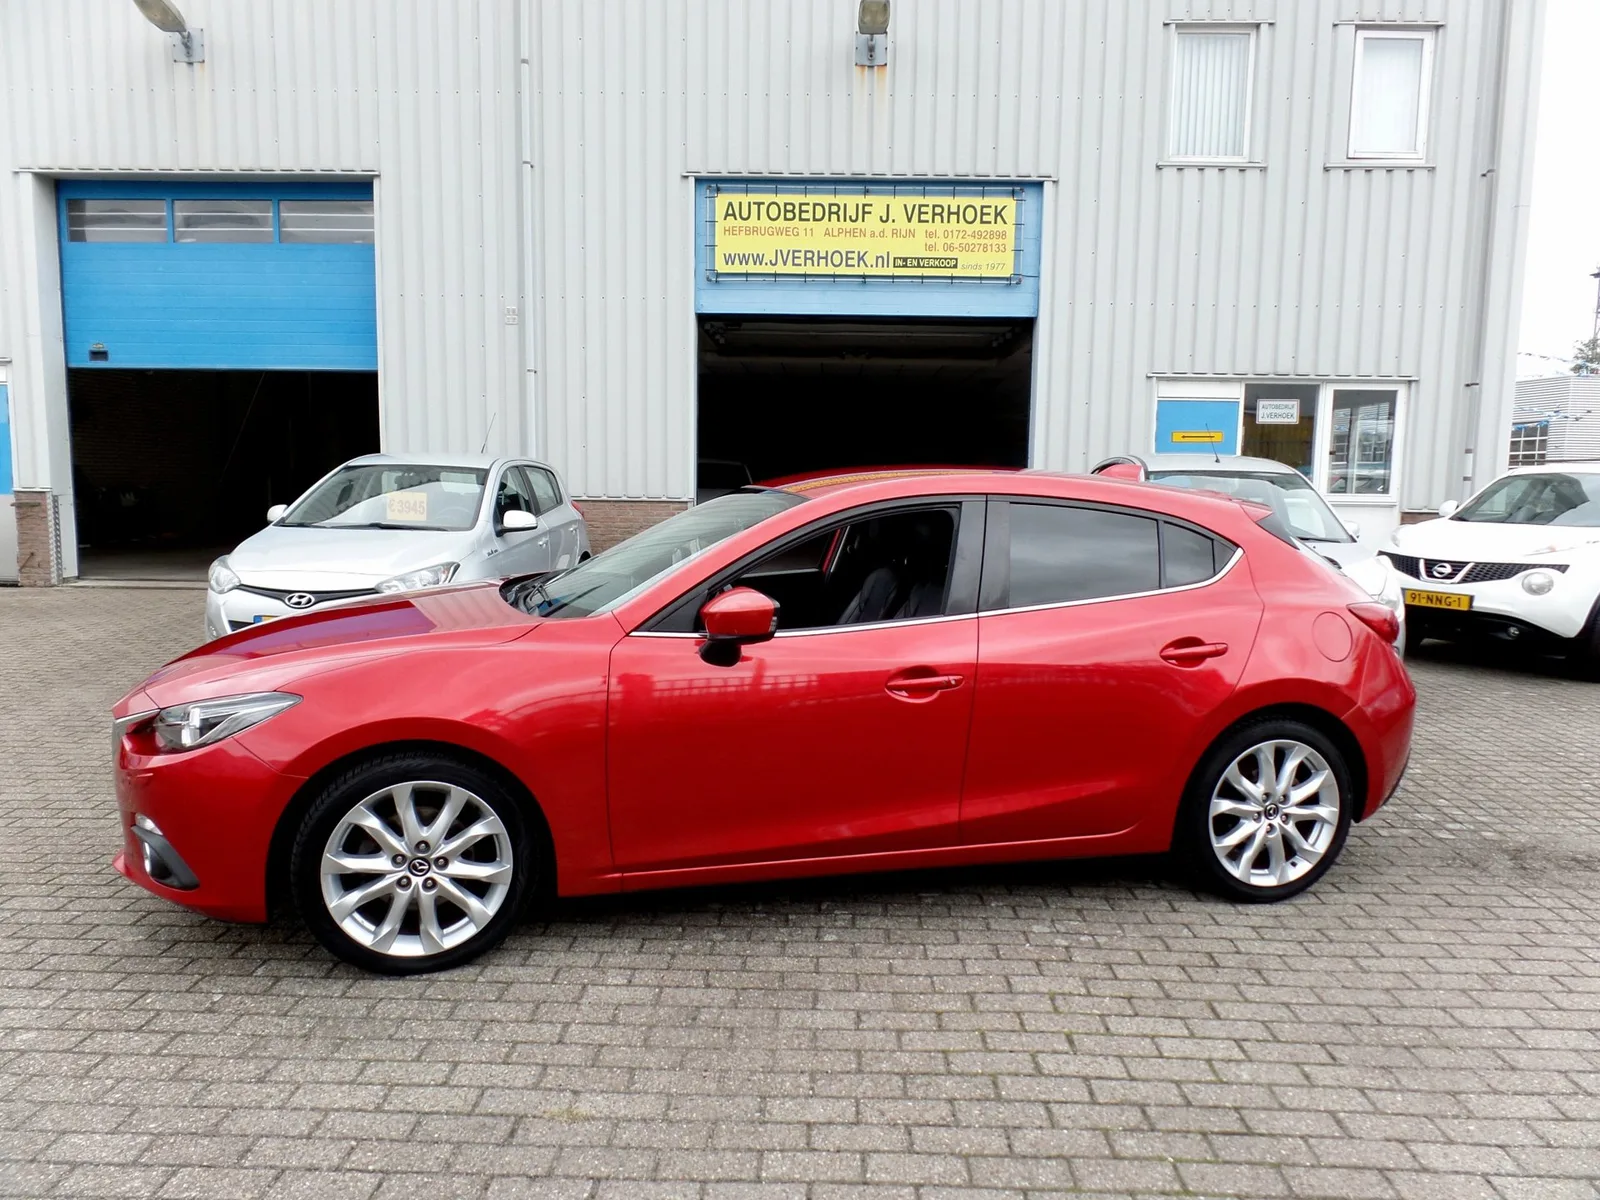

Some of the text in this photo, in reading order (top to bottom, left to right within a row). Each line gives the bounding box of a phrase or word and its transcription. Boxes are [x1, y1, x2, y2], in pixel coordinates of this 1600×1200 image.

[723, 201, 1008, 224] AUTOBEDRIJF J. VERHOEK
[723, 226, 1007, 240] HEFBRUGWEG 11 ALPHEN a.d. RIJN tel. 0172-492898
[924, 242, 1007, 252] tel. 06-50278133
[723, 249, 891, 268] www.JVERHOEK.nl
[895, 259, 956, 268] IN- EN VERKOOP
[961, 262, 982, 270] sinds
[1410, 592, 1462, 608] 91-NNG-1
